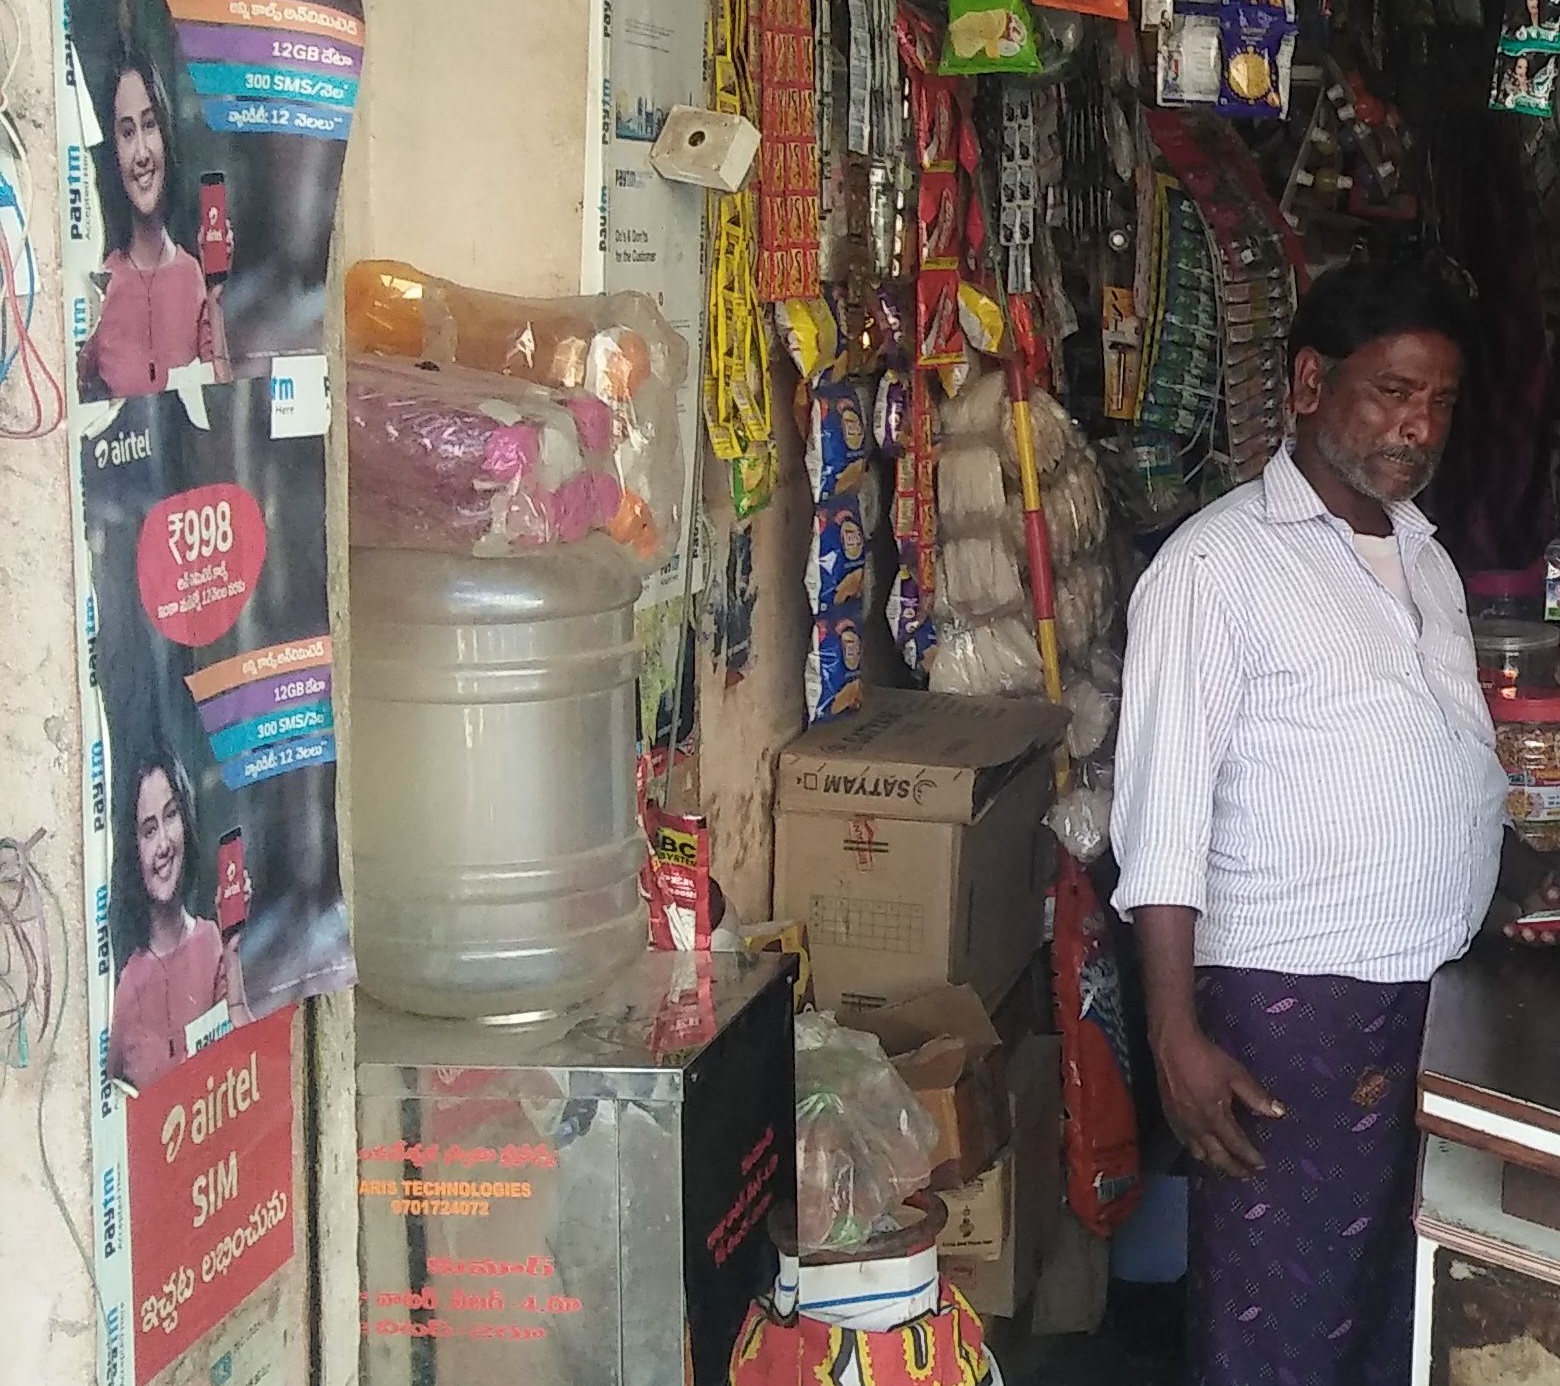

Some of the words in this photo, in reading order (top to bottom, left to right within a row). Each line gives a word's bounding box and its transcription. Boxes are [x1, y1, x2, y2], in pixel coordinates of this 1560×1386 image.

[272, 41, 319, 62] 12GB
[245, 73, 271, 89] 300
[633, 248, 658, 263] Customer
[110, 427, 152, 469] airtel
[167, 500, 233, 565] ₹998
[274, 681, 304, 702] 12GB
[257, 721, 277, 740] 300
[823, 774, 910, 799] SATYAM
[190, 1050, 261, 1145] airtel
[191, 1150, 240, 1229] SIM
[358, 1180, 397, 1196] ARIS
[402, 1180, 532, 1198] TECHNOLOGIES
